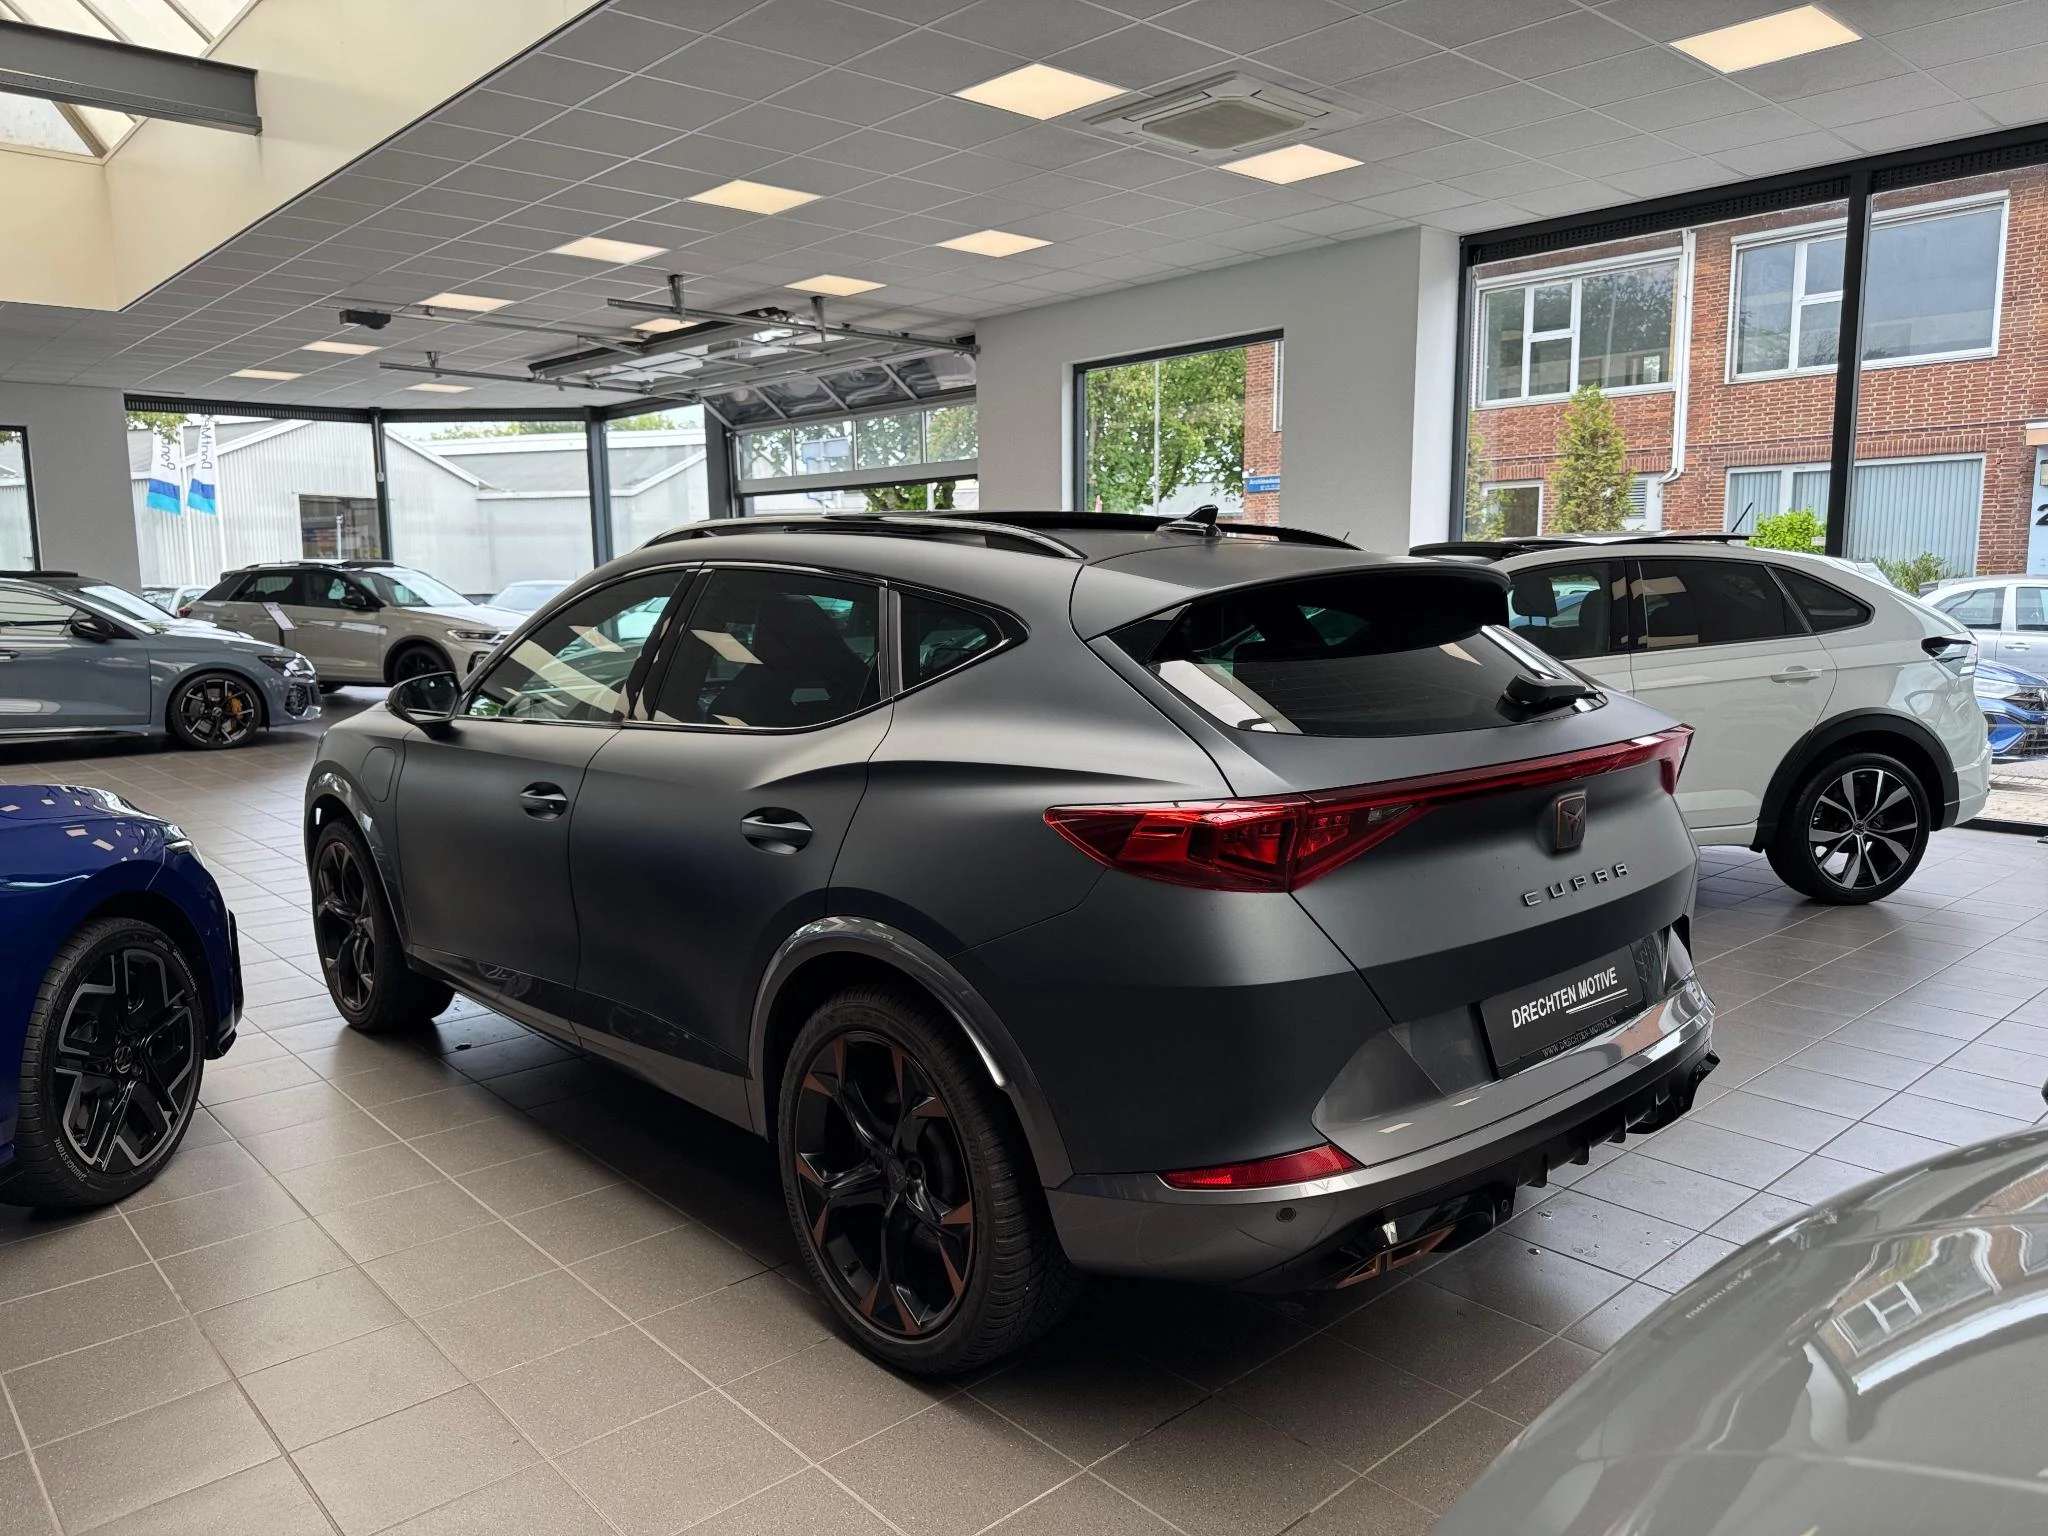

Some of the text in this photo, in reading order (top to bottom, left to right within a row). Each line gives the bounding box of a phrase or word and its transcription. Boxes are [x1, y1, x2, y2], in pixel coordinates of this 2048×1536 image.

[1522, 862, 1629, 907] CUPRA
[1511, 966, 1618, 1029] DRECHTEN MOTIVE
